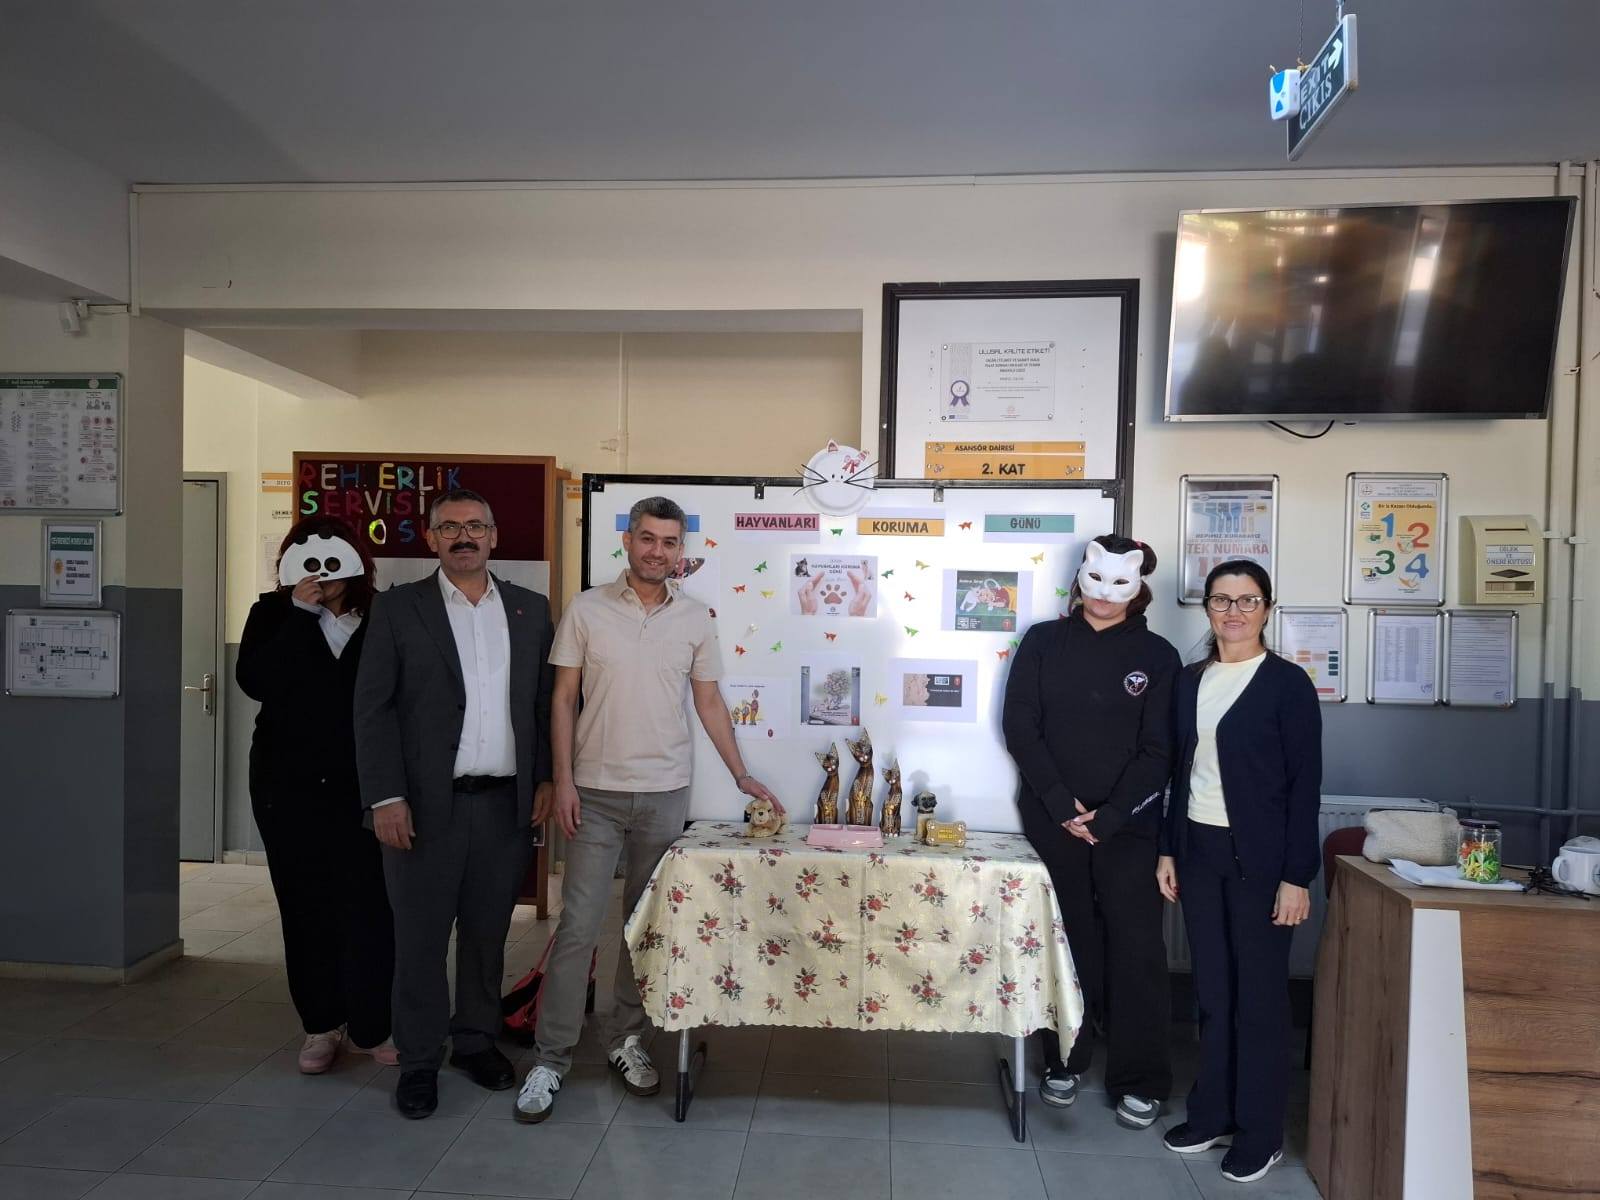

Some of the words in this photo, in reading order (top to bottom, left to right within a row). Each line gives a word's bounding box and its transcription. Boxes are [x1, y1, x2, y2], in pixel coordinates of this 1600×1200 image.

[954, 444, 987, 452] ASANSÖR
[989, 444, 1015, 452] DAİRESİ
[981, 463, 993, 475] 2.
[999, 463, 1026, 475] KAT
[736, 516, 816, 530] HAYVANLARI
[872, 520, 929, 533] KORUMA
[1010, 518, 1041, 529] GÜNÜ
[1381, 513, 1394, 537] 1
[1408, 522, 1429, 547] 2
[1186, 543, 1209, 554] TEK
[1213, 543, 1270, 554] NUMARA
[1375, 550, 1395, 574] 3
[1405, 553, 1429, 578] 4
